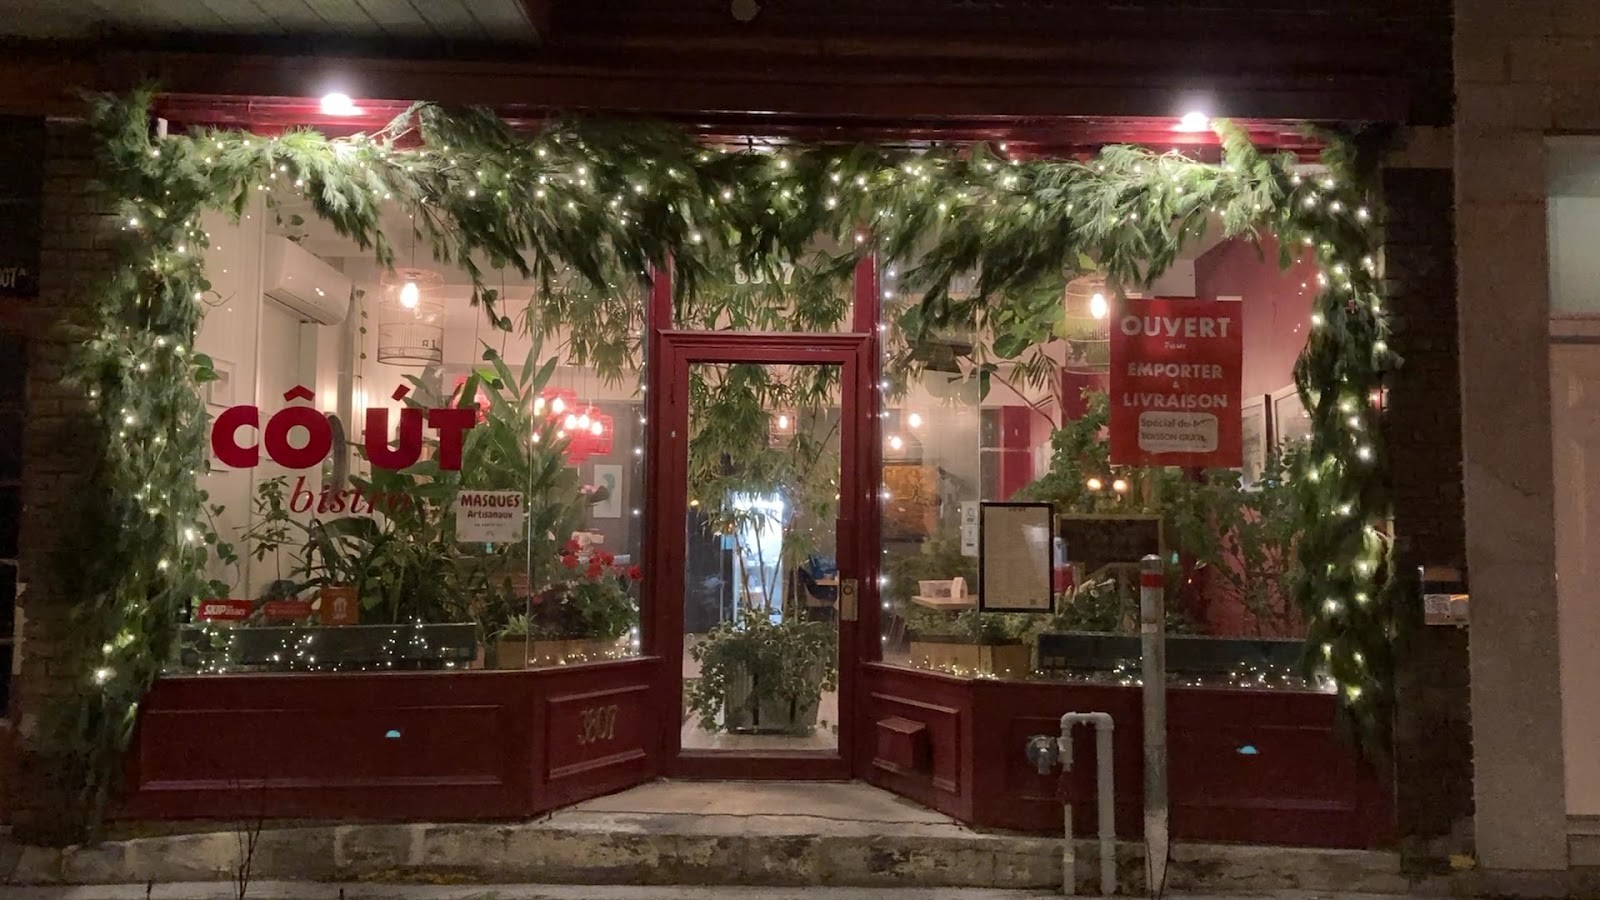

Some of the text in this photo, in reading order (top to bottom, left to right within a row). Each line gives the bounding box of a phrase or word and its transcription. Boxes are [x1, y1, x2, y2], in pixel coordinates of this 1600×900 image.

[1120, 316, 1231, 338] OUVERT
[1127, 362, 1223, 379] EMPORTER
[1122, 392, 1228, 409] LIVRAISON
[211, 384, 476, 471] CÔ ÚT
[461, 494, 520, 508] MASQUES
[467, 510, 513, 519] Artisanaux
